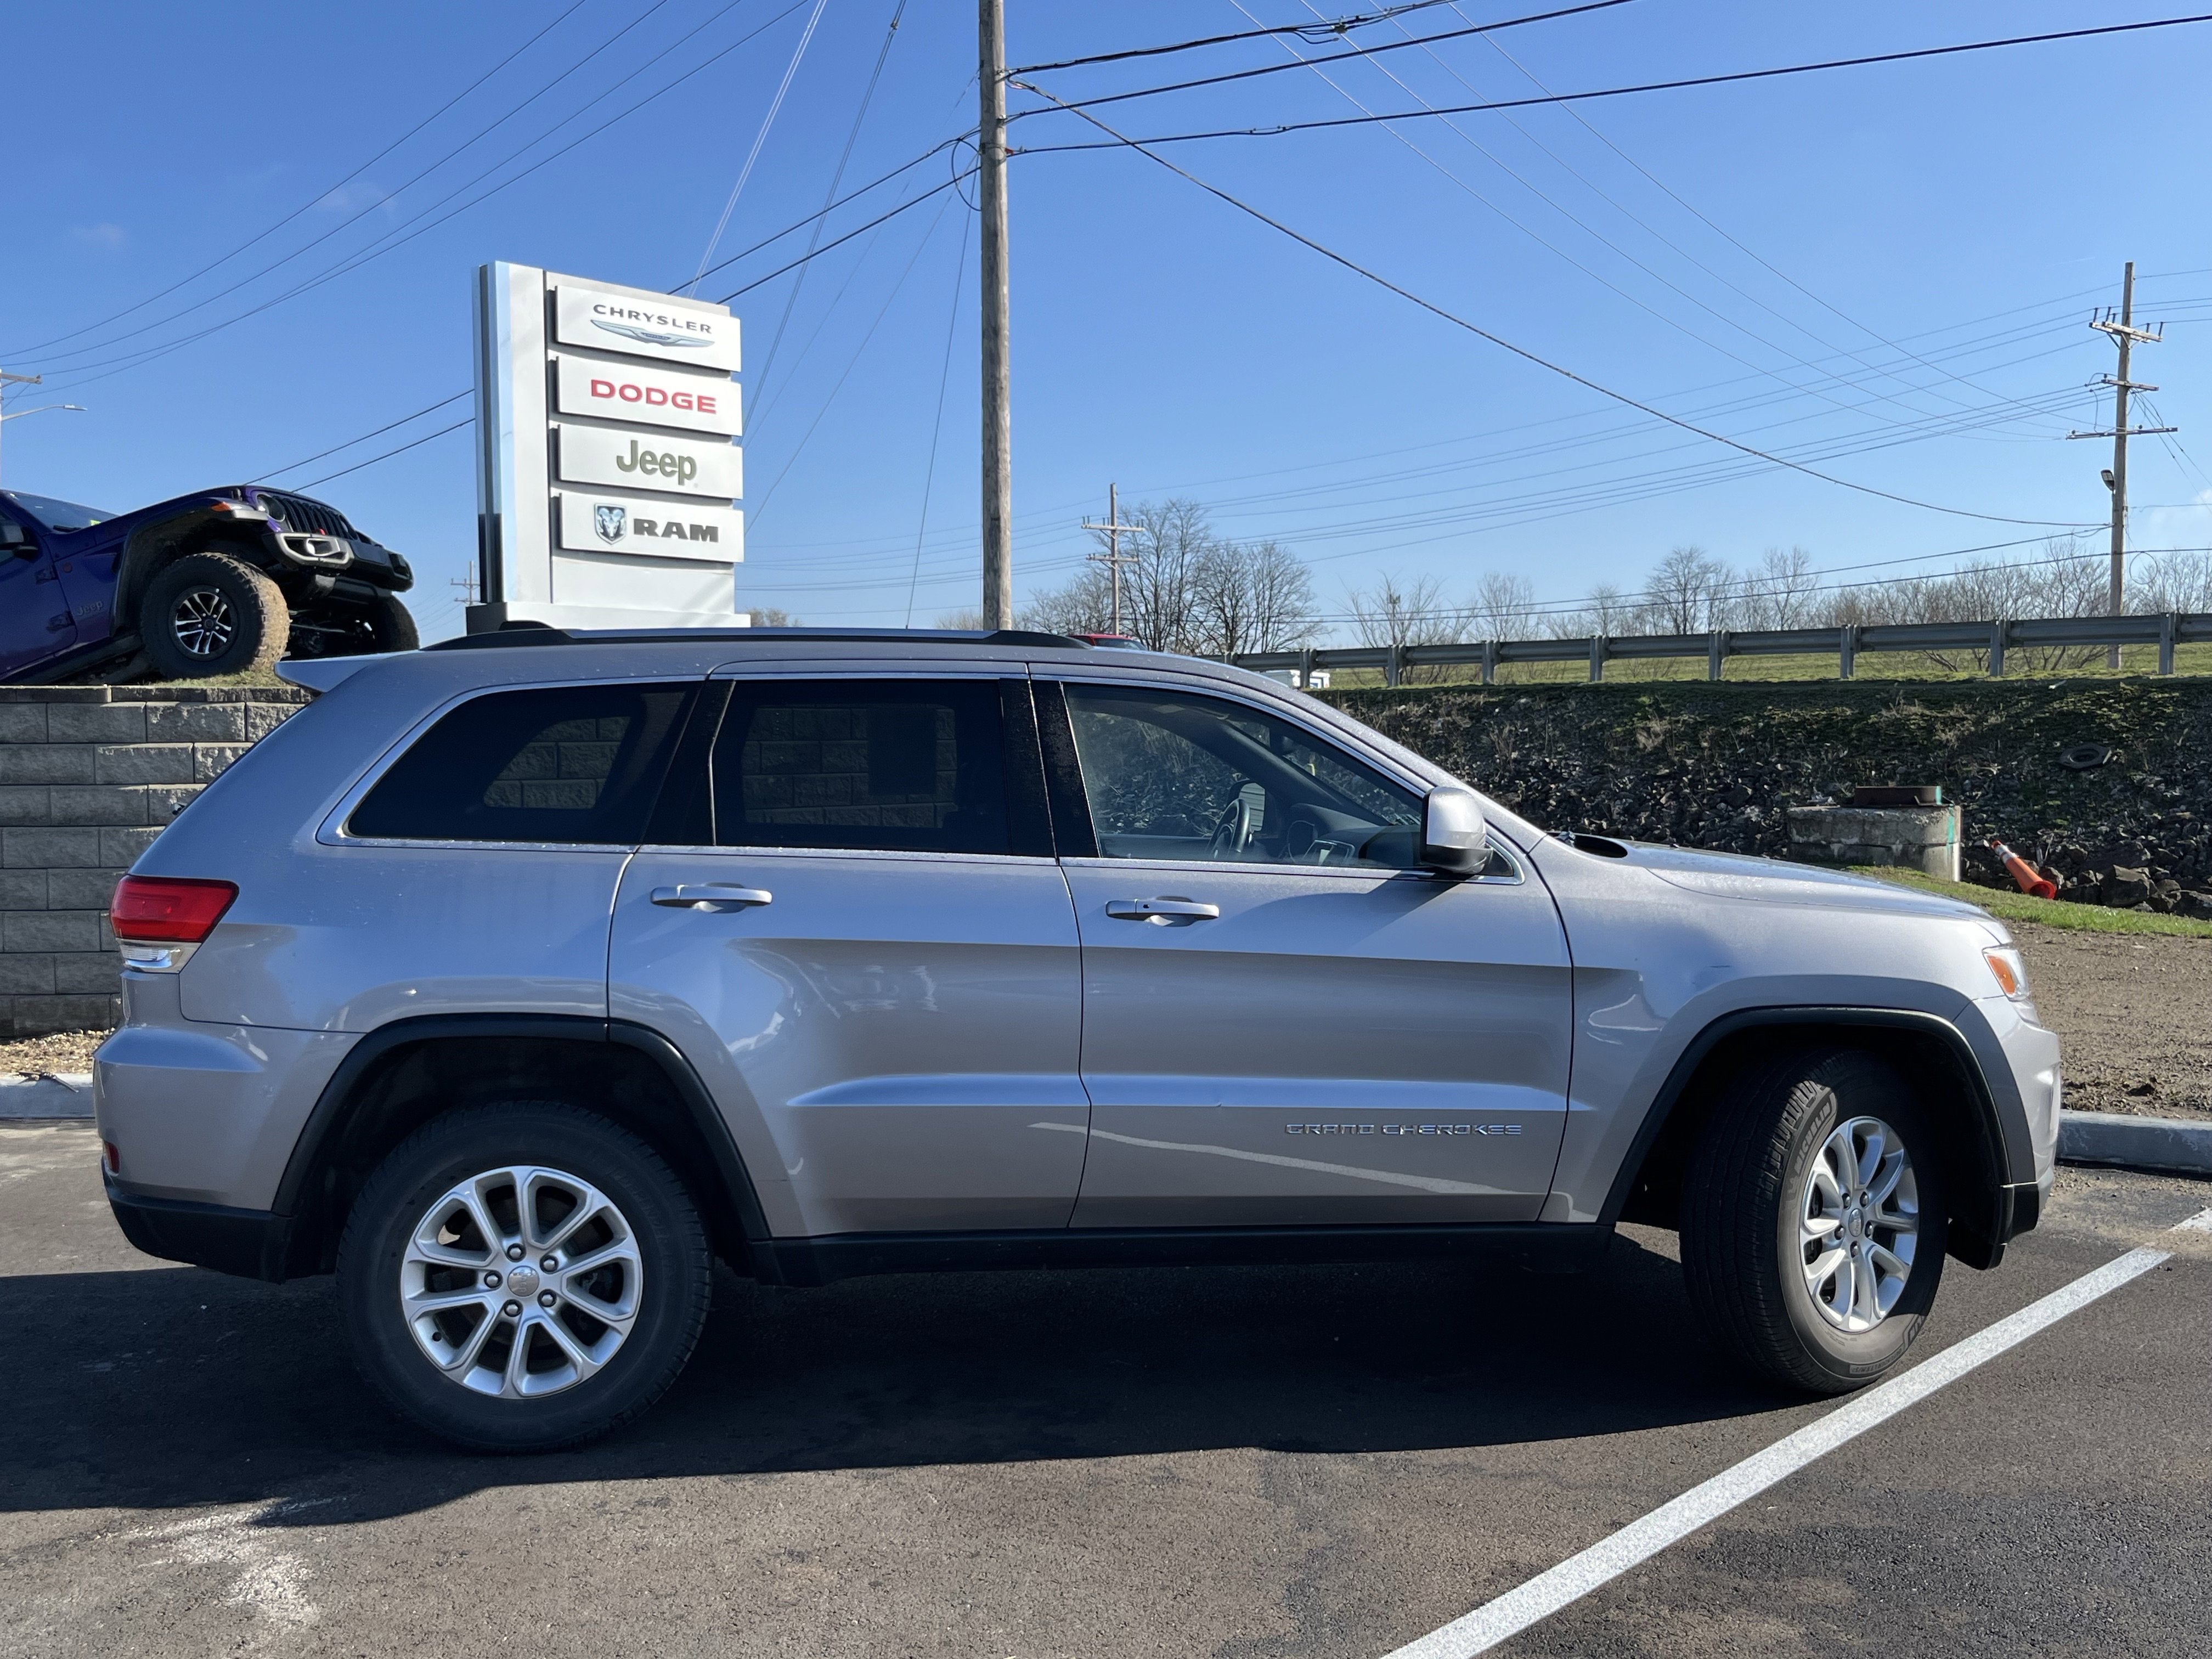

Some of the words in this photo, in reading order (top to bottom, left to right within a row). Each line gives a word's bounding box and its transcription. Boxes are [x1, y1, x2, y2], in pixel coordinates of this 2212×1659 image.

[593, 304, 712, 334] CHRYSLER
[591, 379, 716, 414] DODGE
[616, 439, 697, 486] Jeep
[633, 518, 719, 543] RAM
[76, 600, 104, 616] Jeep
[1285, 1124, 1374, 1135] GRAND
[1381, 1124, 1522, 1135] CHEROKEE
[1794, 1102, 1831, 1175] MICHELIN
